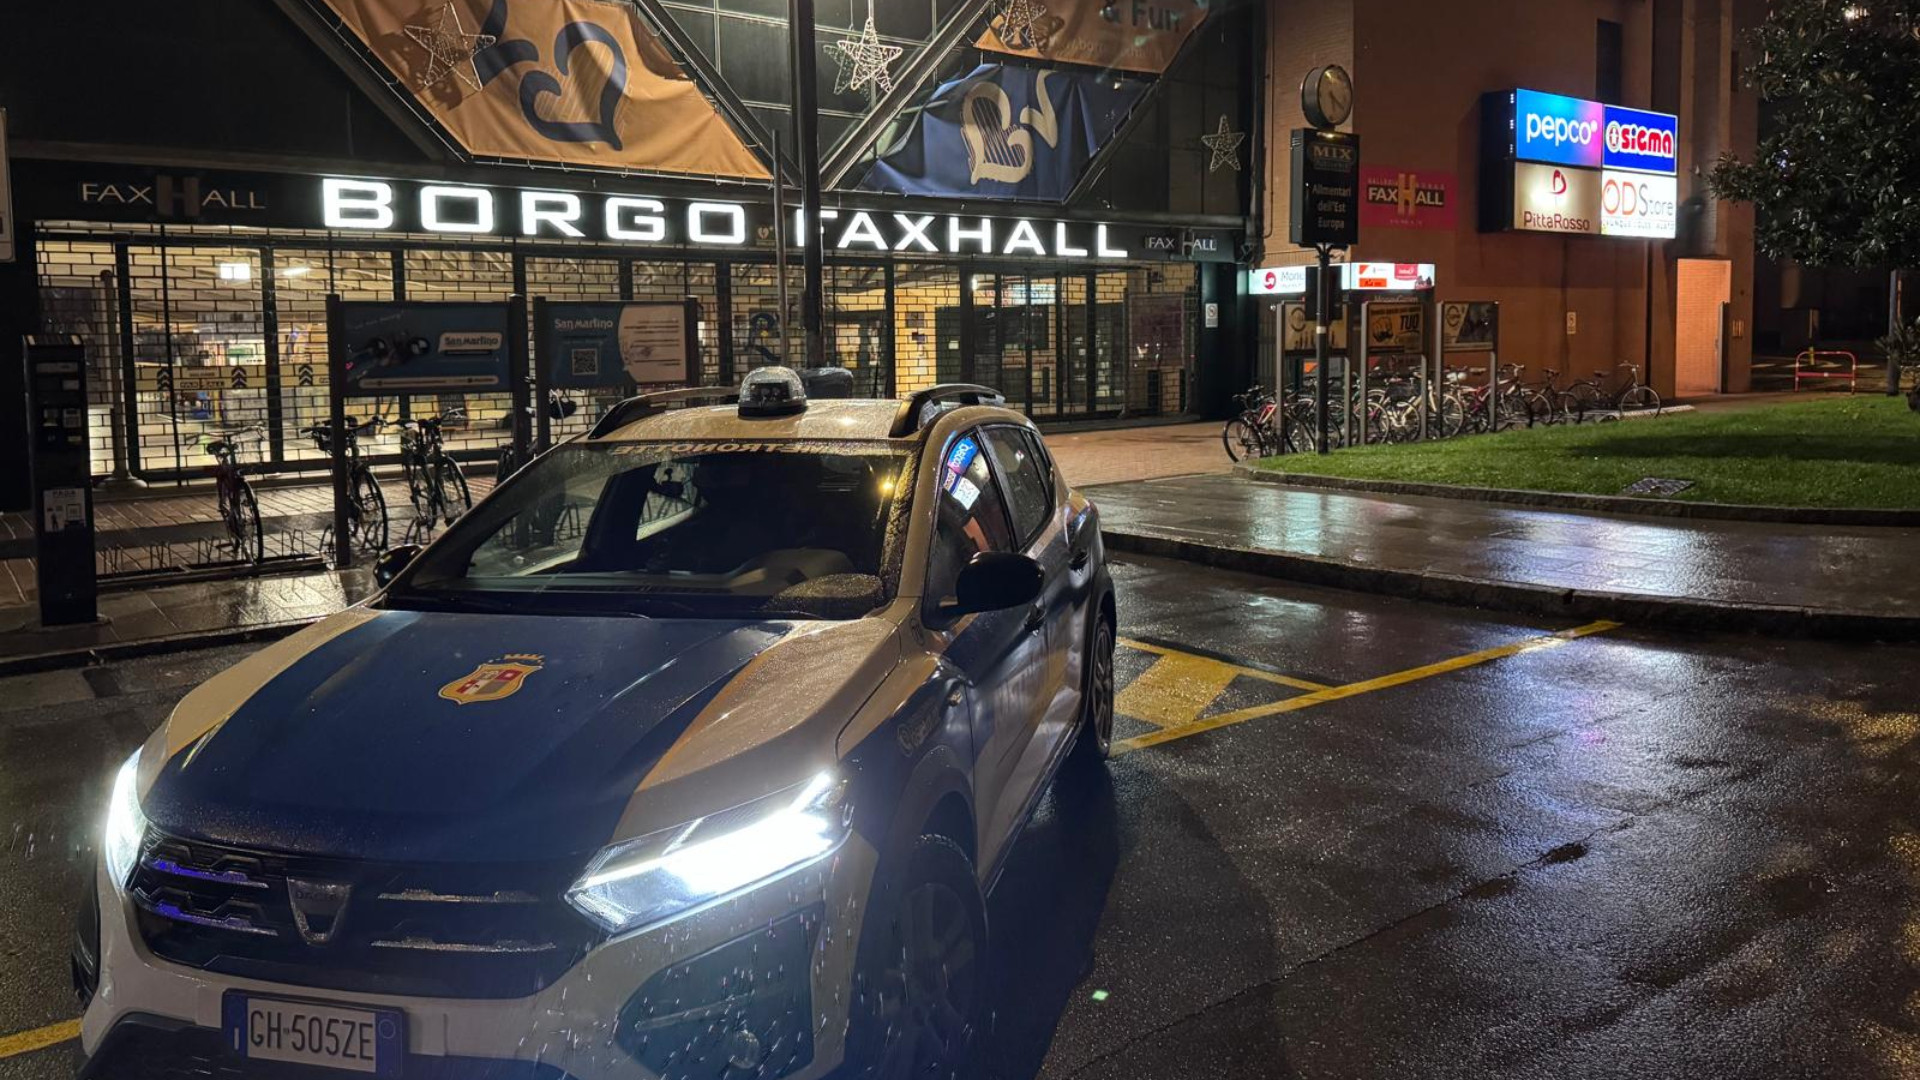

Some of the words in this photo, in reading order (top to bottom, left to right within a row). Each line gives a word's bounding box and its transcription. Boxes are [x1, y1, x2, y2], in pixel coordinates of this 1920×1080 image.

[1526, 112, 1592, 147] pepco
[1313, 145, 1352, 160] MIX
[322, 178, 747, 245] BORGO
[796, 208, 1129, 258] FAXHALL
[1317, 216, 1346, 231] Europa
[1523, 210, 1591, 231] PittaRosso
[554, 318, 573, 331] San
